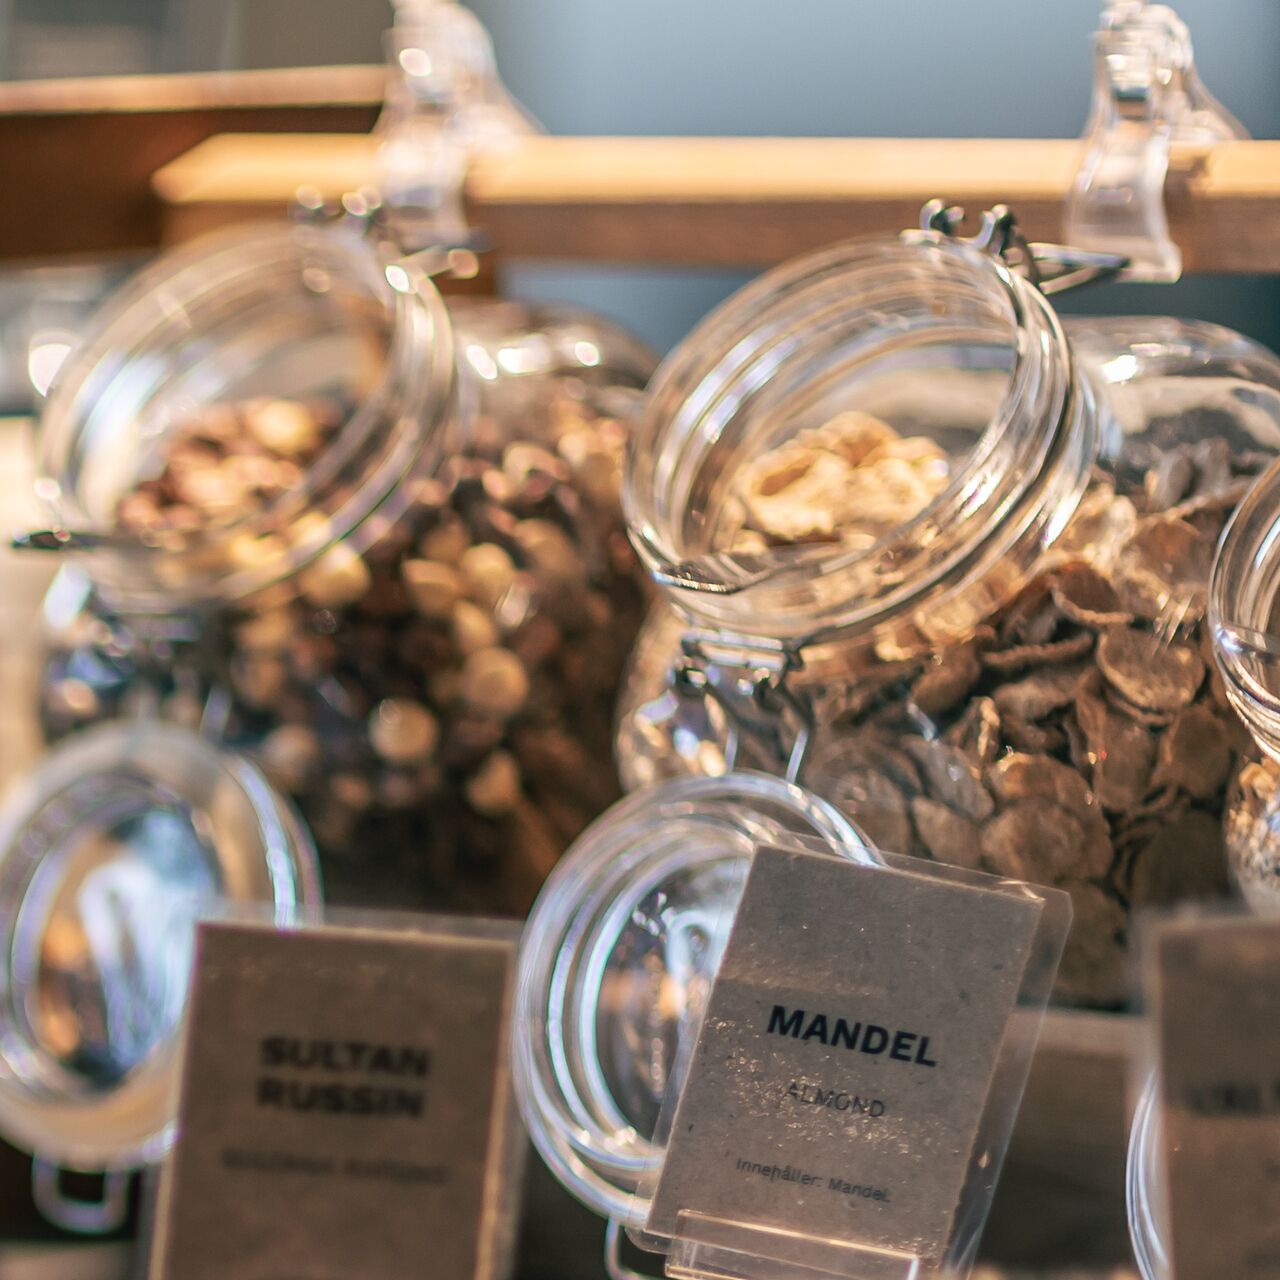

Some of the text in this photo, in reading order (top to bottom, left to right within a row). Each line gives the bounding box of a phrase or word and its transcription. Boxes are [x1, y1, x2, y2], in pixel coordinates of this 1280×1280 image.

[261, 1035, 431, 1078] SULTAN
[766, 1005, 938, 1067] MANDEL
[255, 1076, 426, 1118] RUSSIN
[782, 1081, 887, 1118] ALMOND
